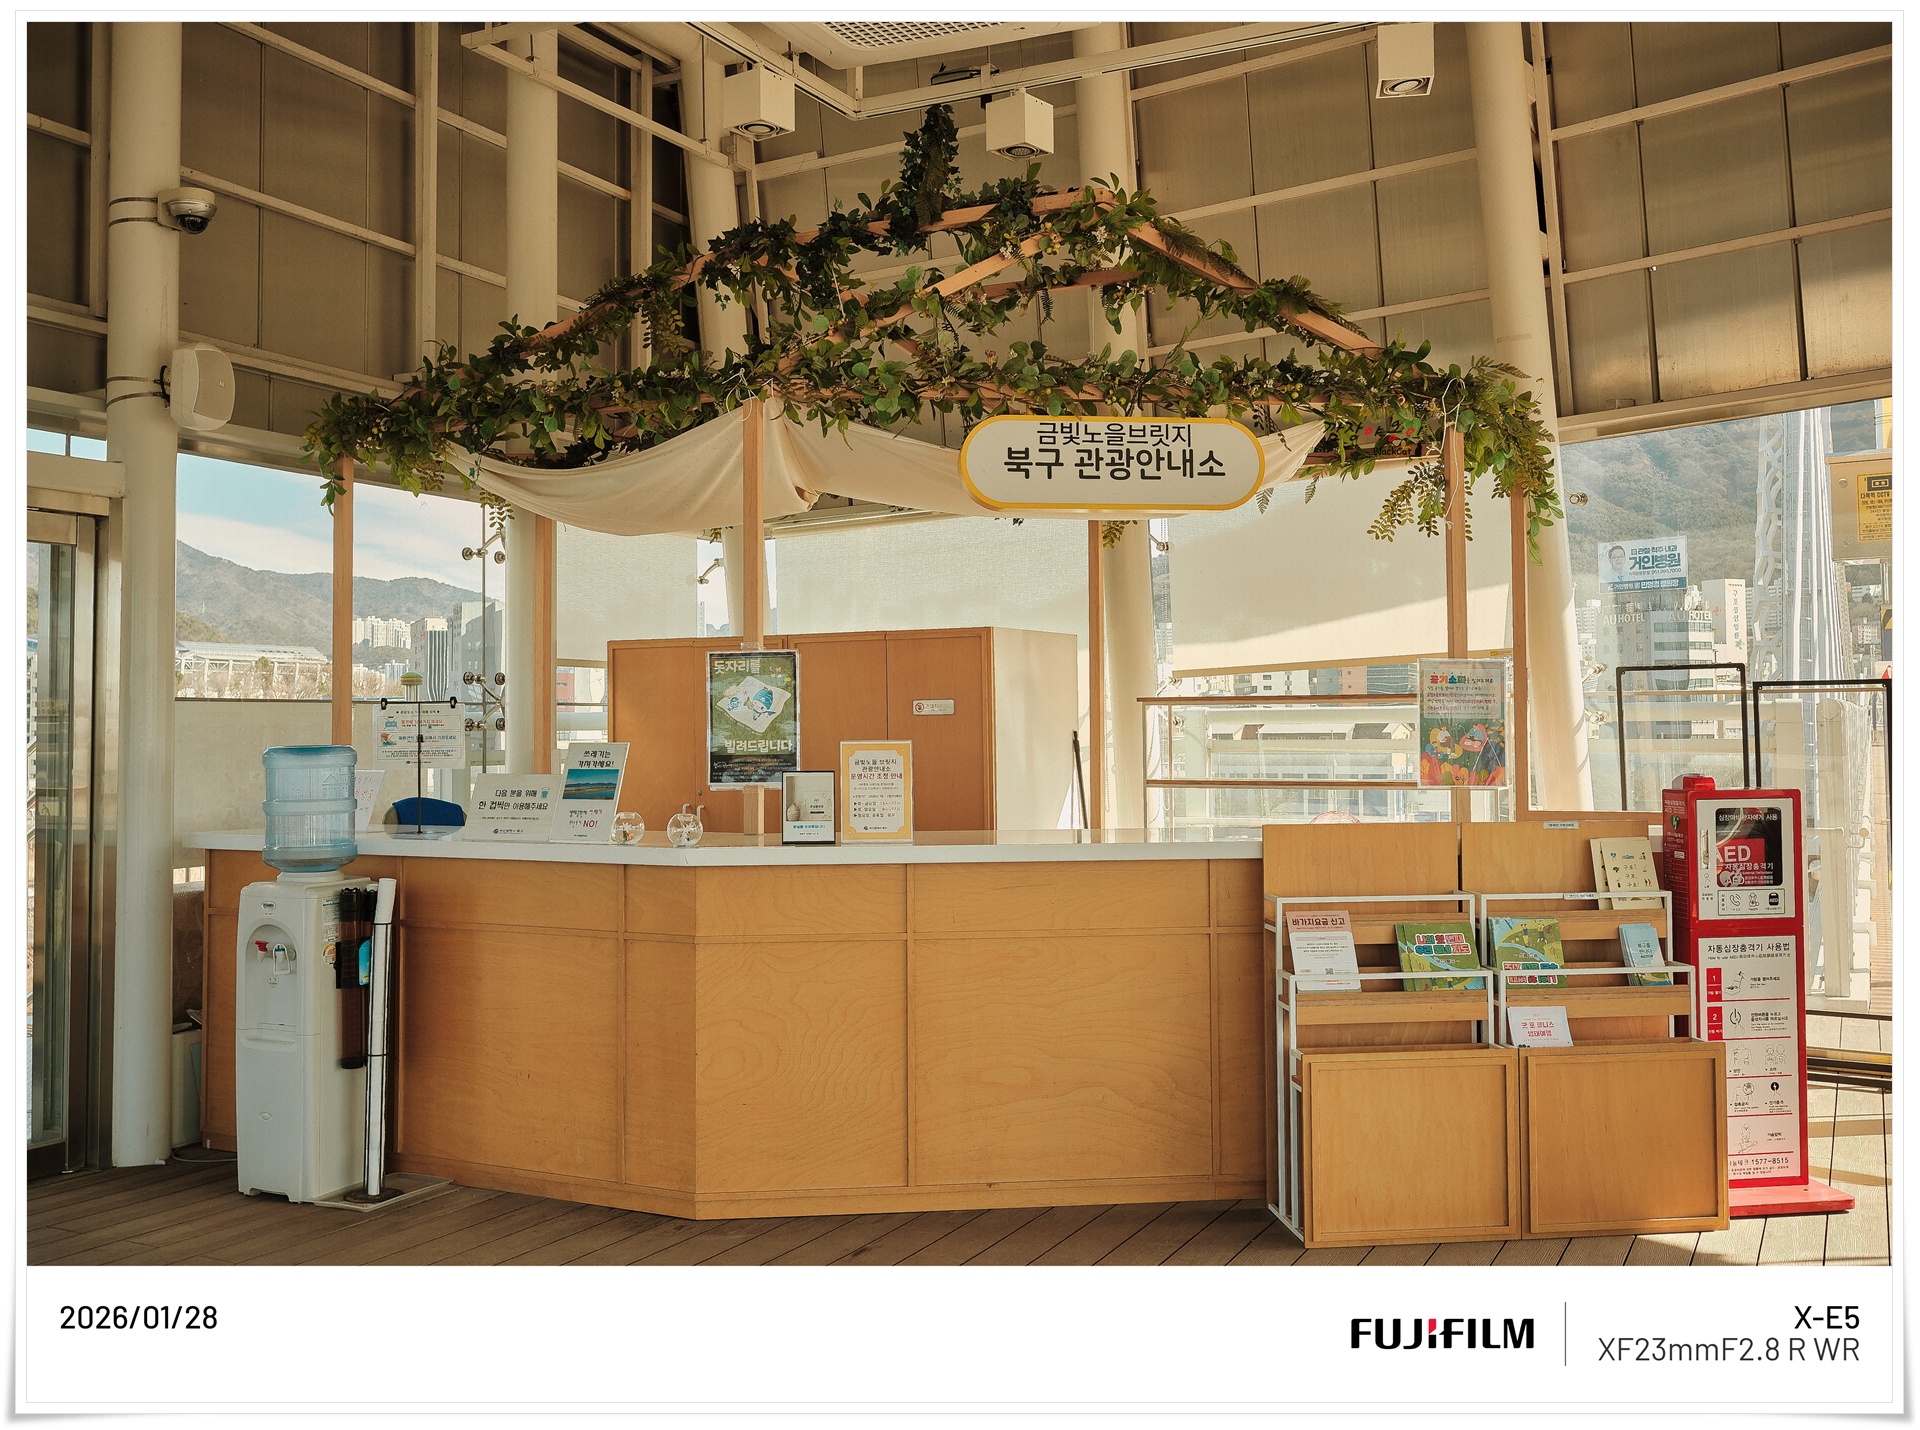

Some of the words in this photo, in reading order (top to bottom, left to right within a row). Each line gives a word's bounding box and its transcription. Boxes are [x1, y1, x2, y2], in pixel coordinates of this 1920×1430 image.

[1037, 422, 1192, 447] 금빛노을브릿지
[1004, 447, 1064, 479] 북구
[1074, 447, 1226, 480] 관광안내소
[1629, 553, 1681, 570] 거인병원
[1617, 613, 1646, 623] HOTEL
[1668, 611, 1686, 621] AU
[1689, 610, 1712, 620] HOTEL
[714, 659, 761, 675] 돗자리를
[724, 739, 793, 753] 빌려드립니다
[583, 750, 611, 758] 쓰레기는
[495, 789, 507, 797] 다음
[510, 789, 522, 797] 분을
[525, 789, 537, 797] 위해
[479, 800, 487, 810] 한
[489, 800, 510, 810] 컵씩만
[513, 802, 548, 810] 이용해주세요
[1766, 813, 1778, 821] 사용
[1292, 918, 1329, 926] 바가지요금
[1330, 917, 1346, 925] 신고
[1416, 935, 1435, 944] 나의
[1415, 945, 1433, 955] 우리
[1452, 944, 1470, 953] 지도
[1708, 943, 1763, 953] 자동심장충격기
[1766, 942, 1790, 951] 사용법
[1751, 1157, 1789, 1165] 1577-8515
